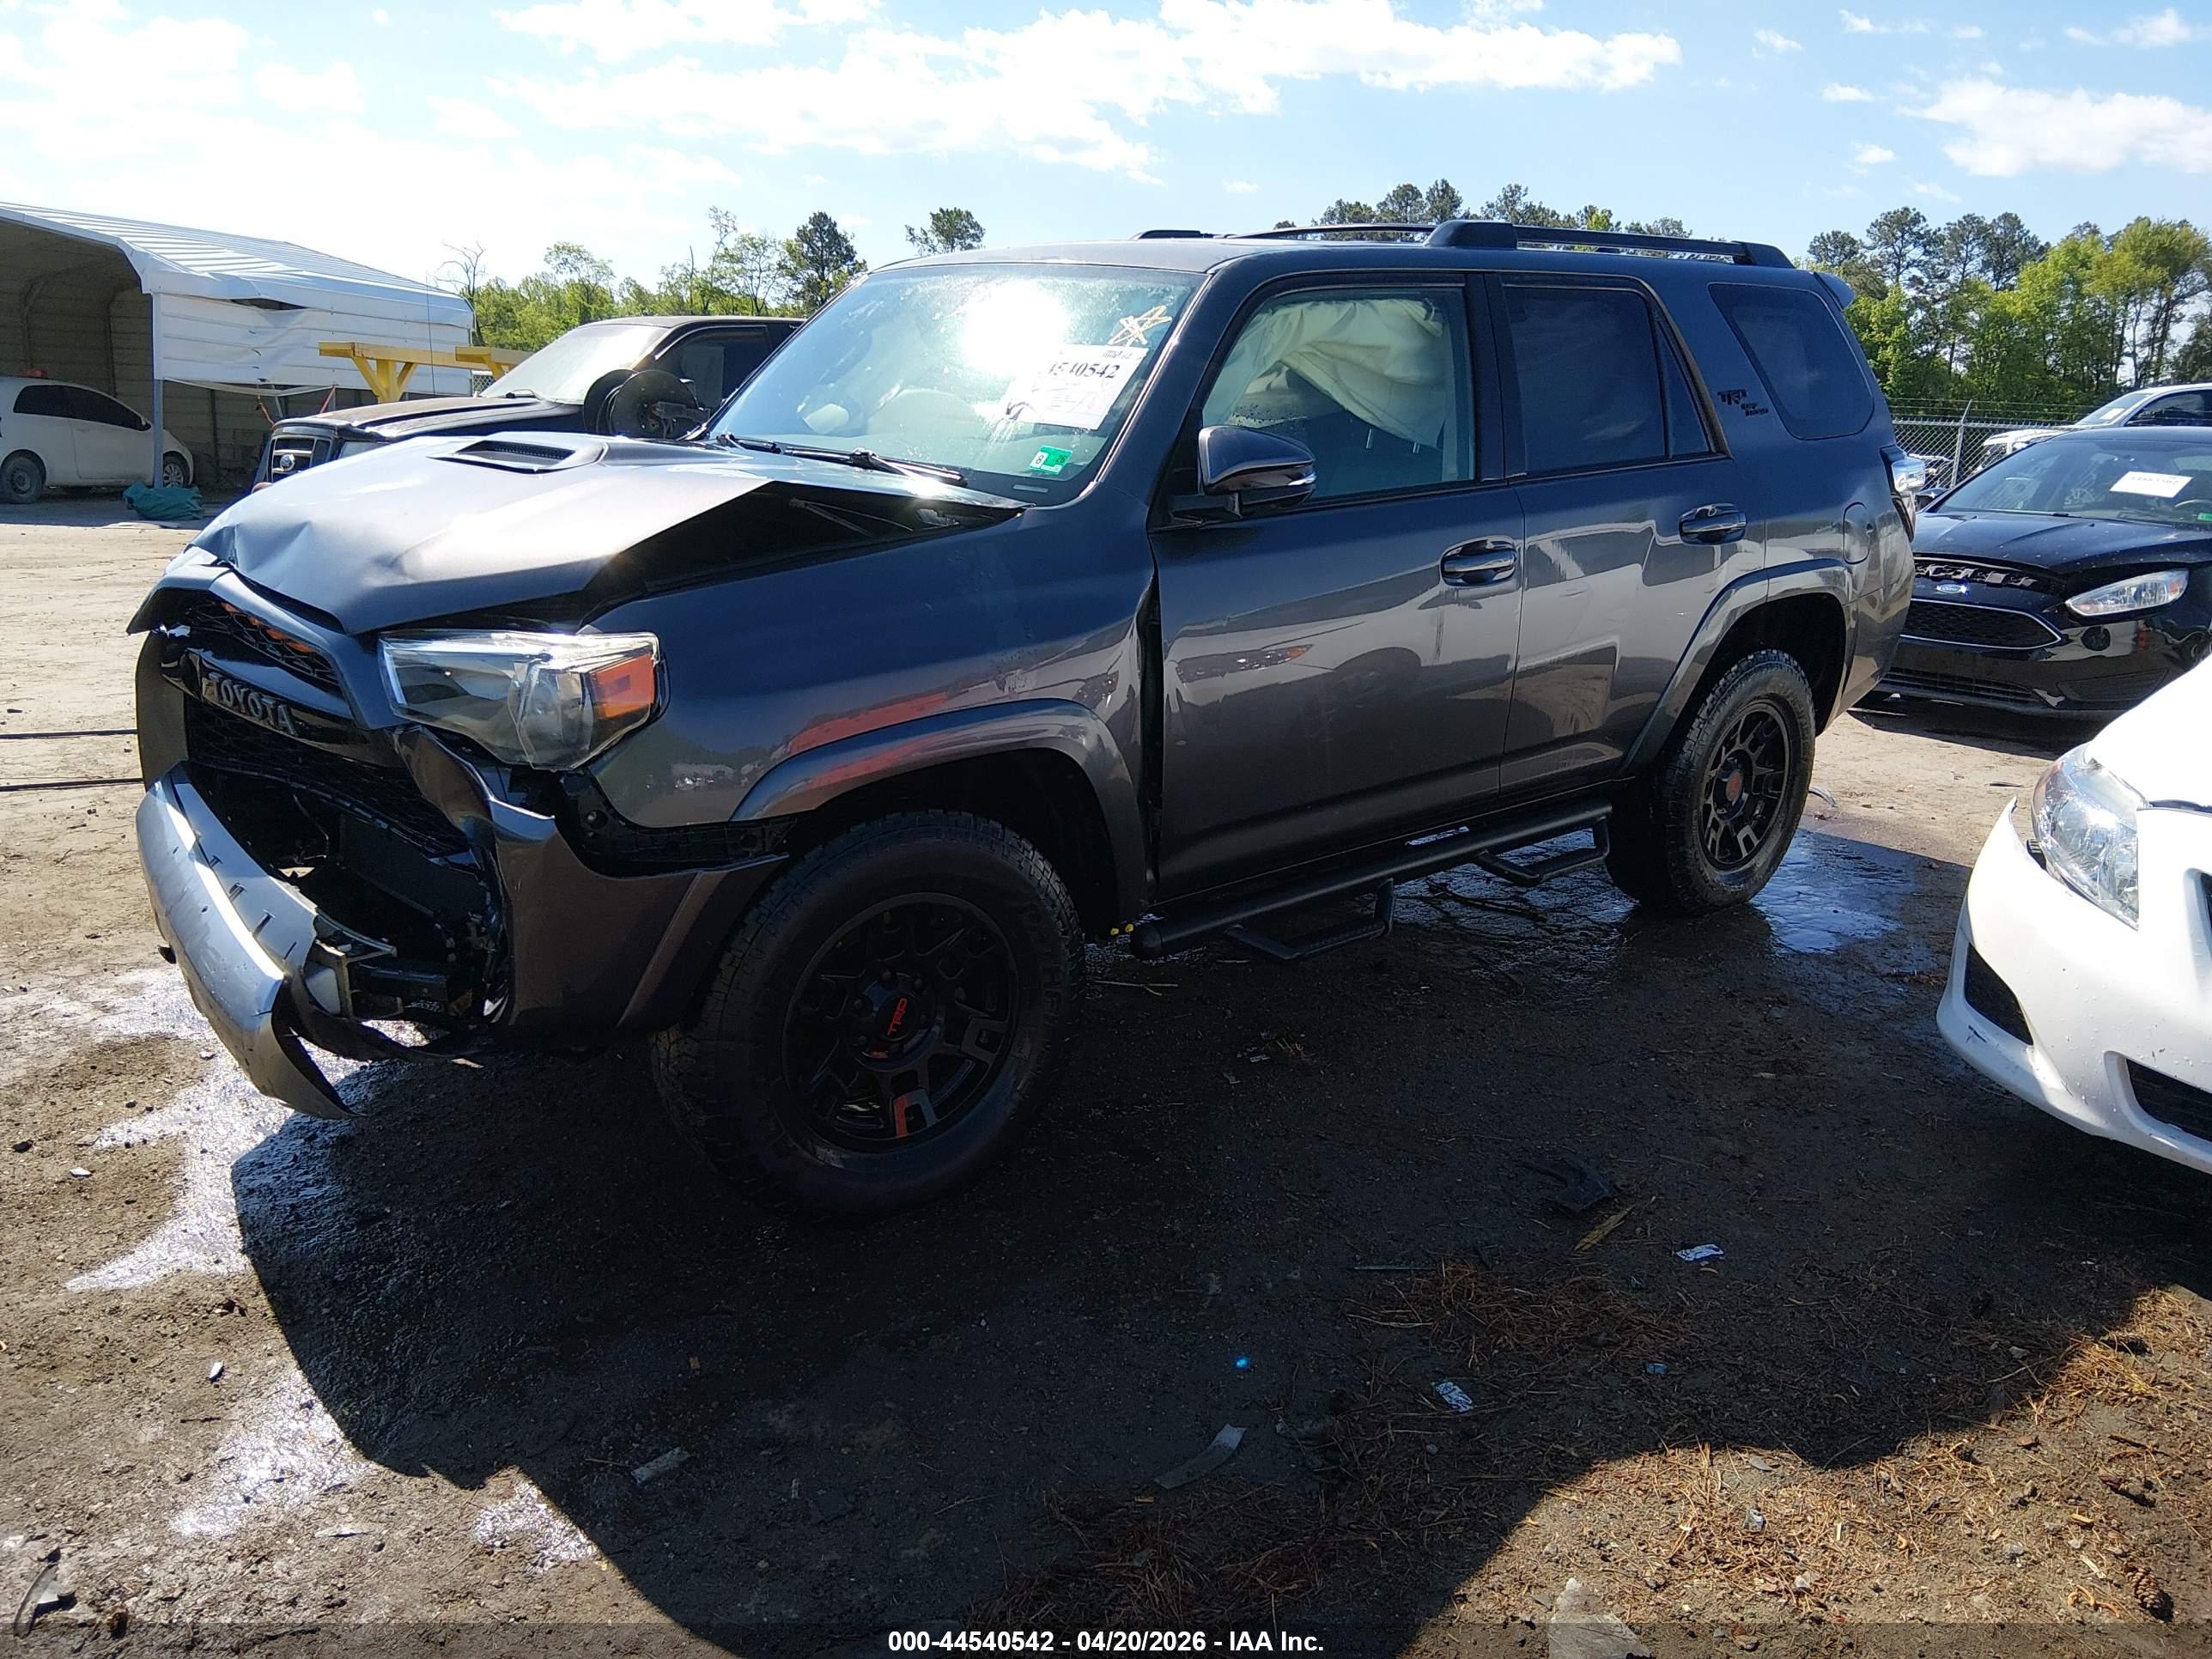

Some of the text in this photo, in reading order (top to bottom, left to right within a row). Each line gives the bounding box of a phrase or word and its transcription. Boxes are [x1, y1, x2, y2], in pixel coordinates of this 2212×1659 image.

[1036, 454, 1066, 465] 8 26
[208, 672, 298, 737] TOYOTA
